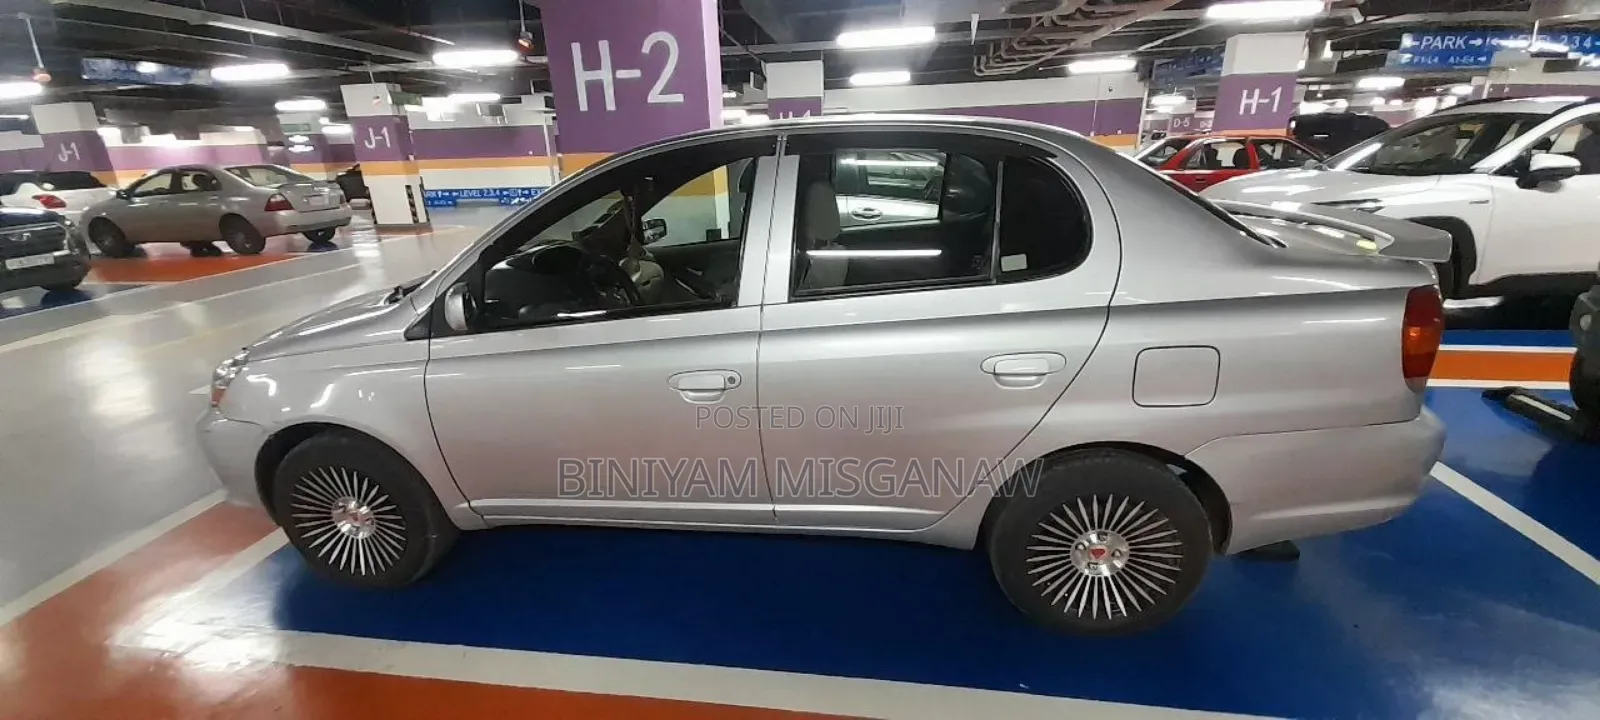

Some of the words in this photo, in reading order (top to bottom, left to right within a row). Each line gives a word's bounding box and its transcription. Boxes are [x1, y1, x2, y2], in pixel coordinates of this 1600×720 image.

[1419, 35, 1468, 50] PARK
[571, 31, 684, 111] H-2
[1239, 87, 1282, 115] H-1
[364, 127, 390, 150] J-1
[58, 142, 80, 162] J-1
[459, 189, 481, 197] LEVEL
